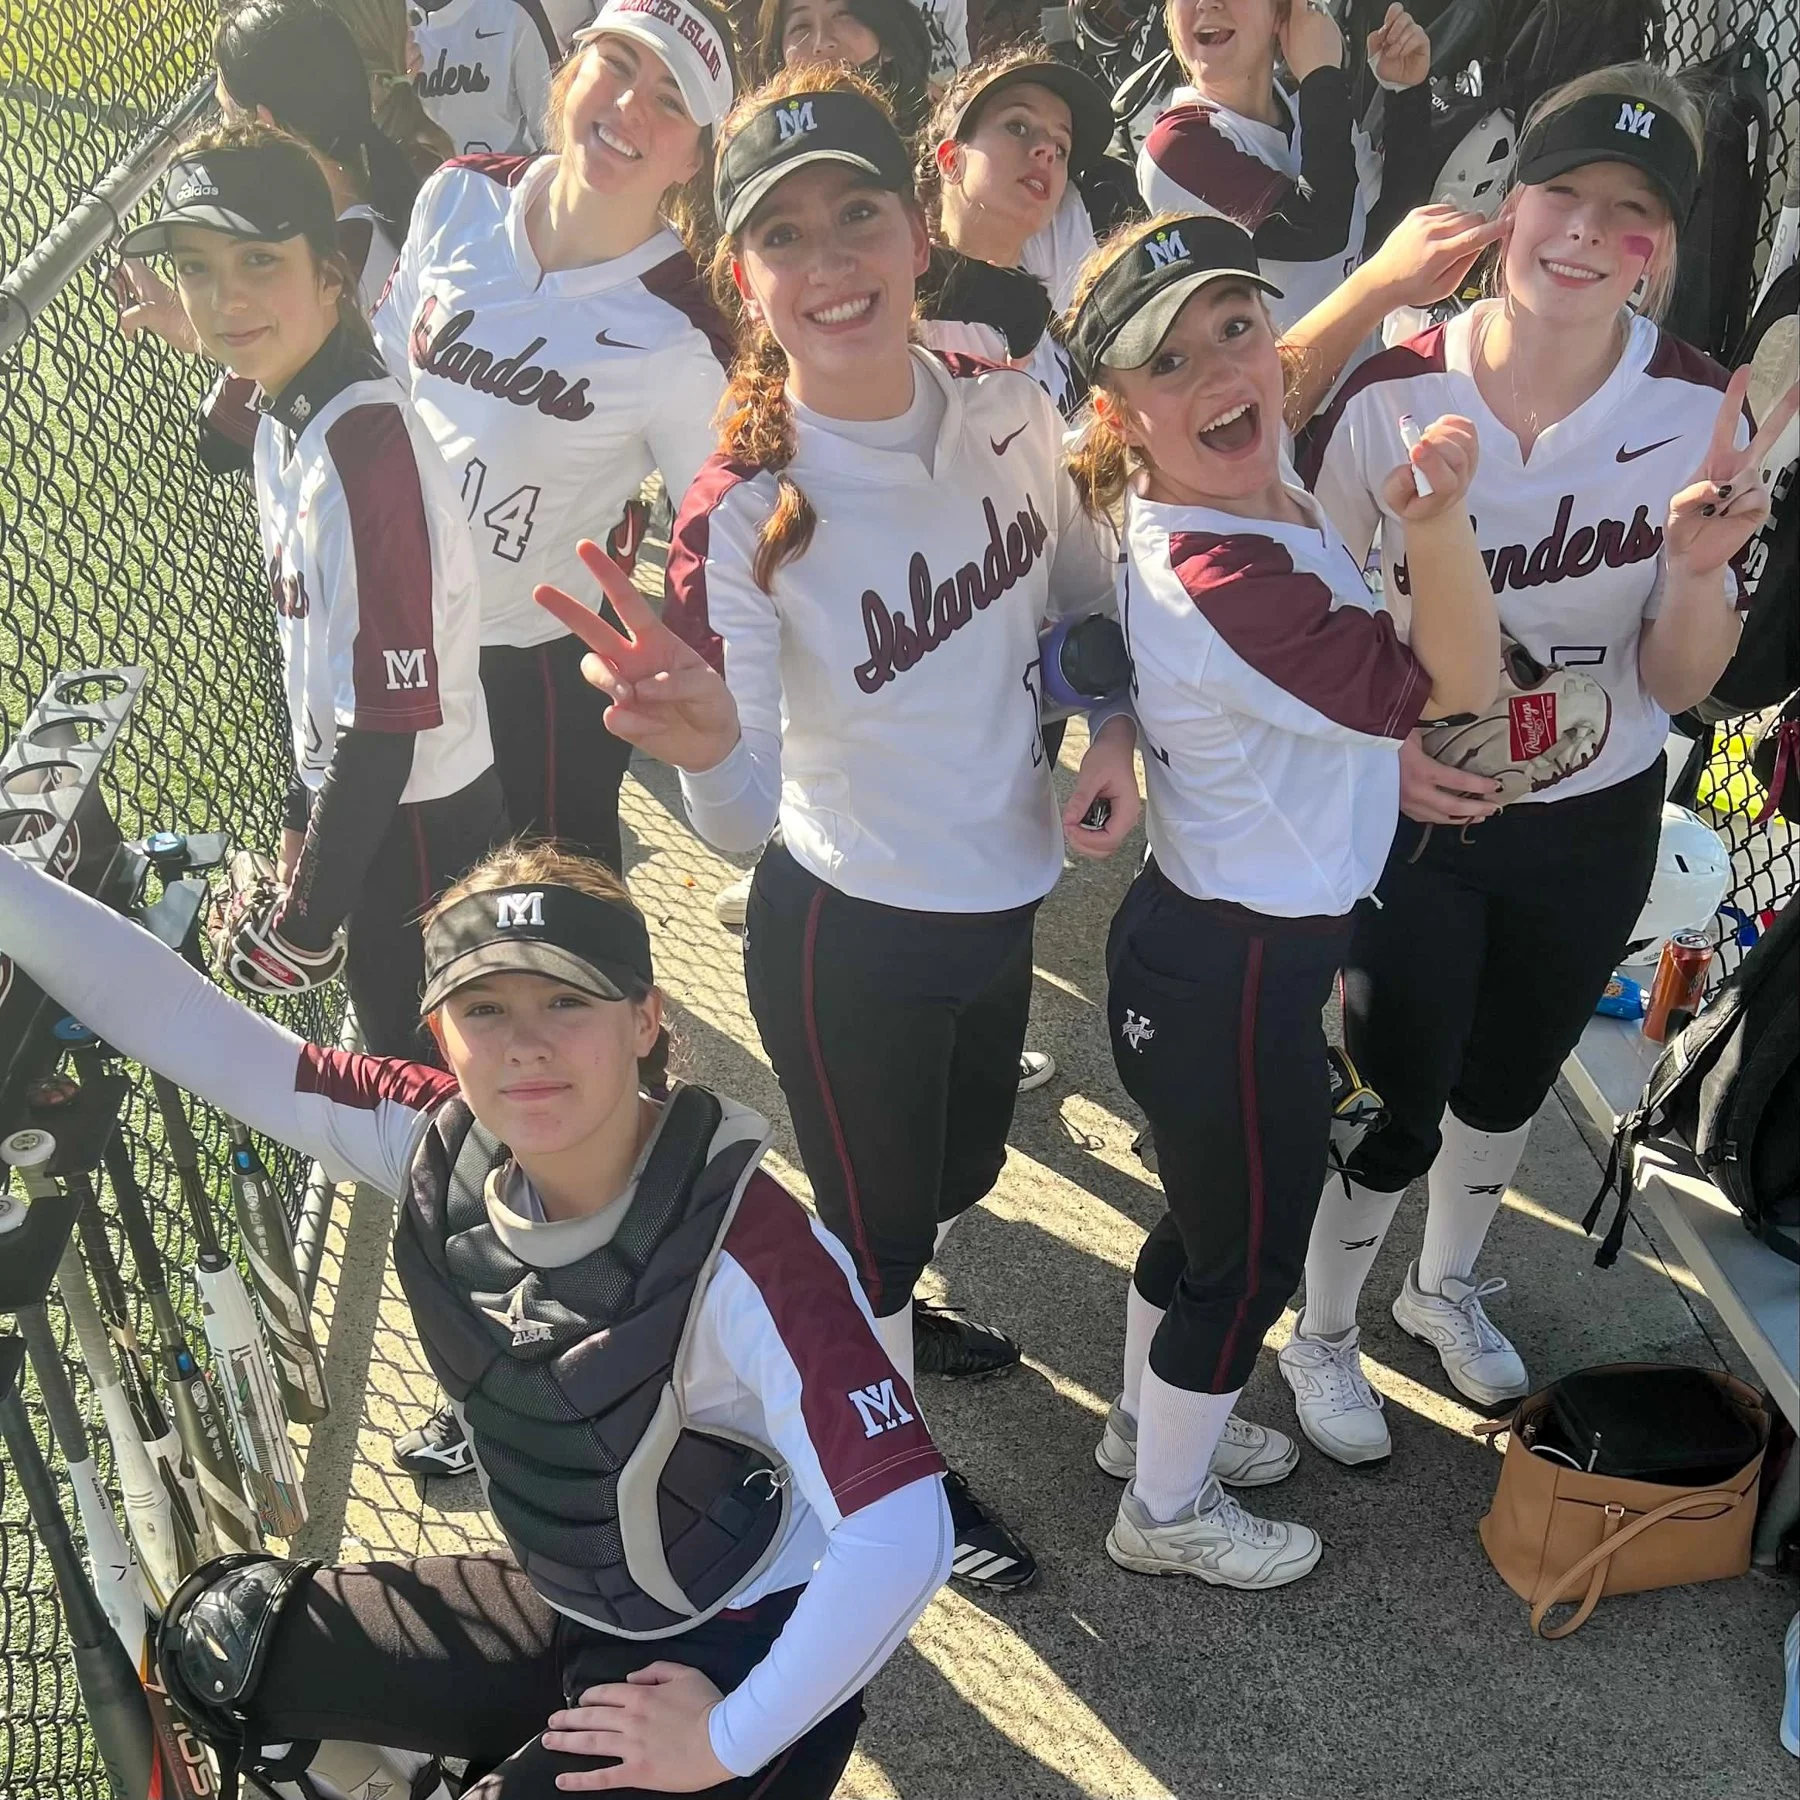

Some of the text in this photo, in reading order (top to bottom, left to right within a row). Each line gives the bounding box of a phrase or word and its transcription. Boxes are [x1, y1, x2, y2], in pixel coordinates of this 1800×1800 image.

[677, 14, 721, 82] ISLAND
[176, 184, 219, 201] adidas
[461, 457, 541, 563] 14
[1520, 701, 1544, 754] Rawlings
[91, 1477, 107, 1510] EASTON
